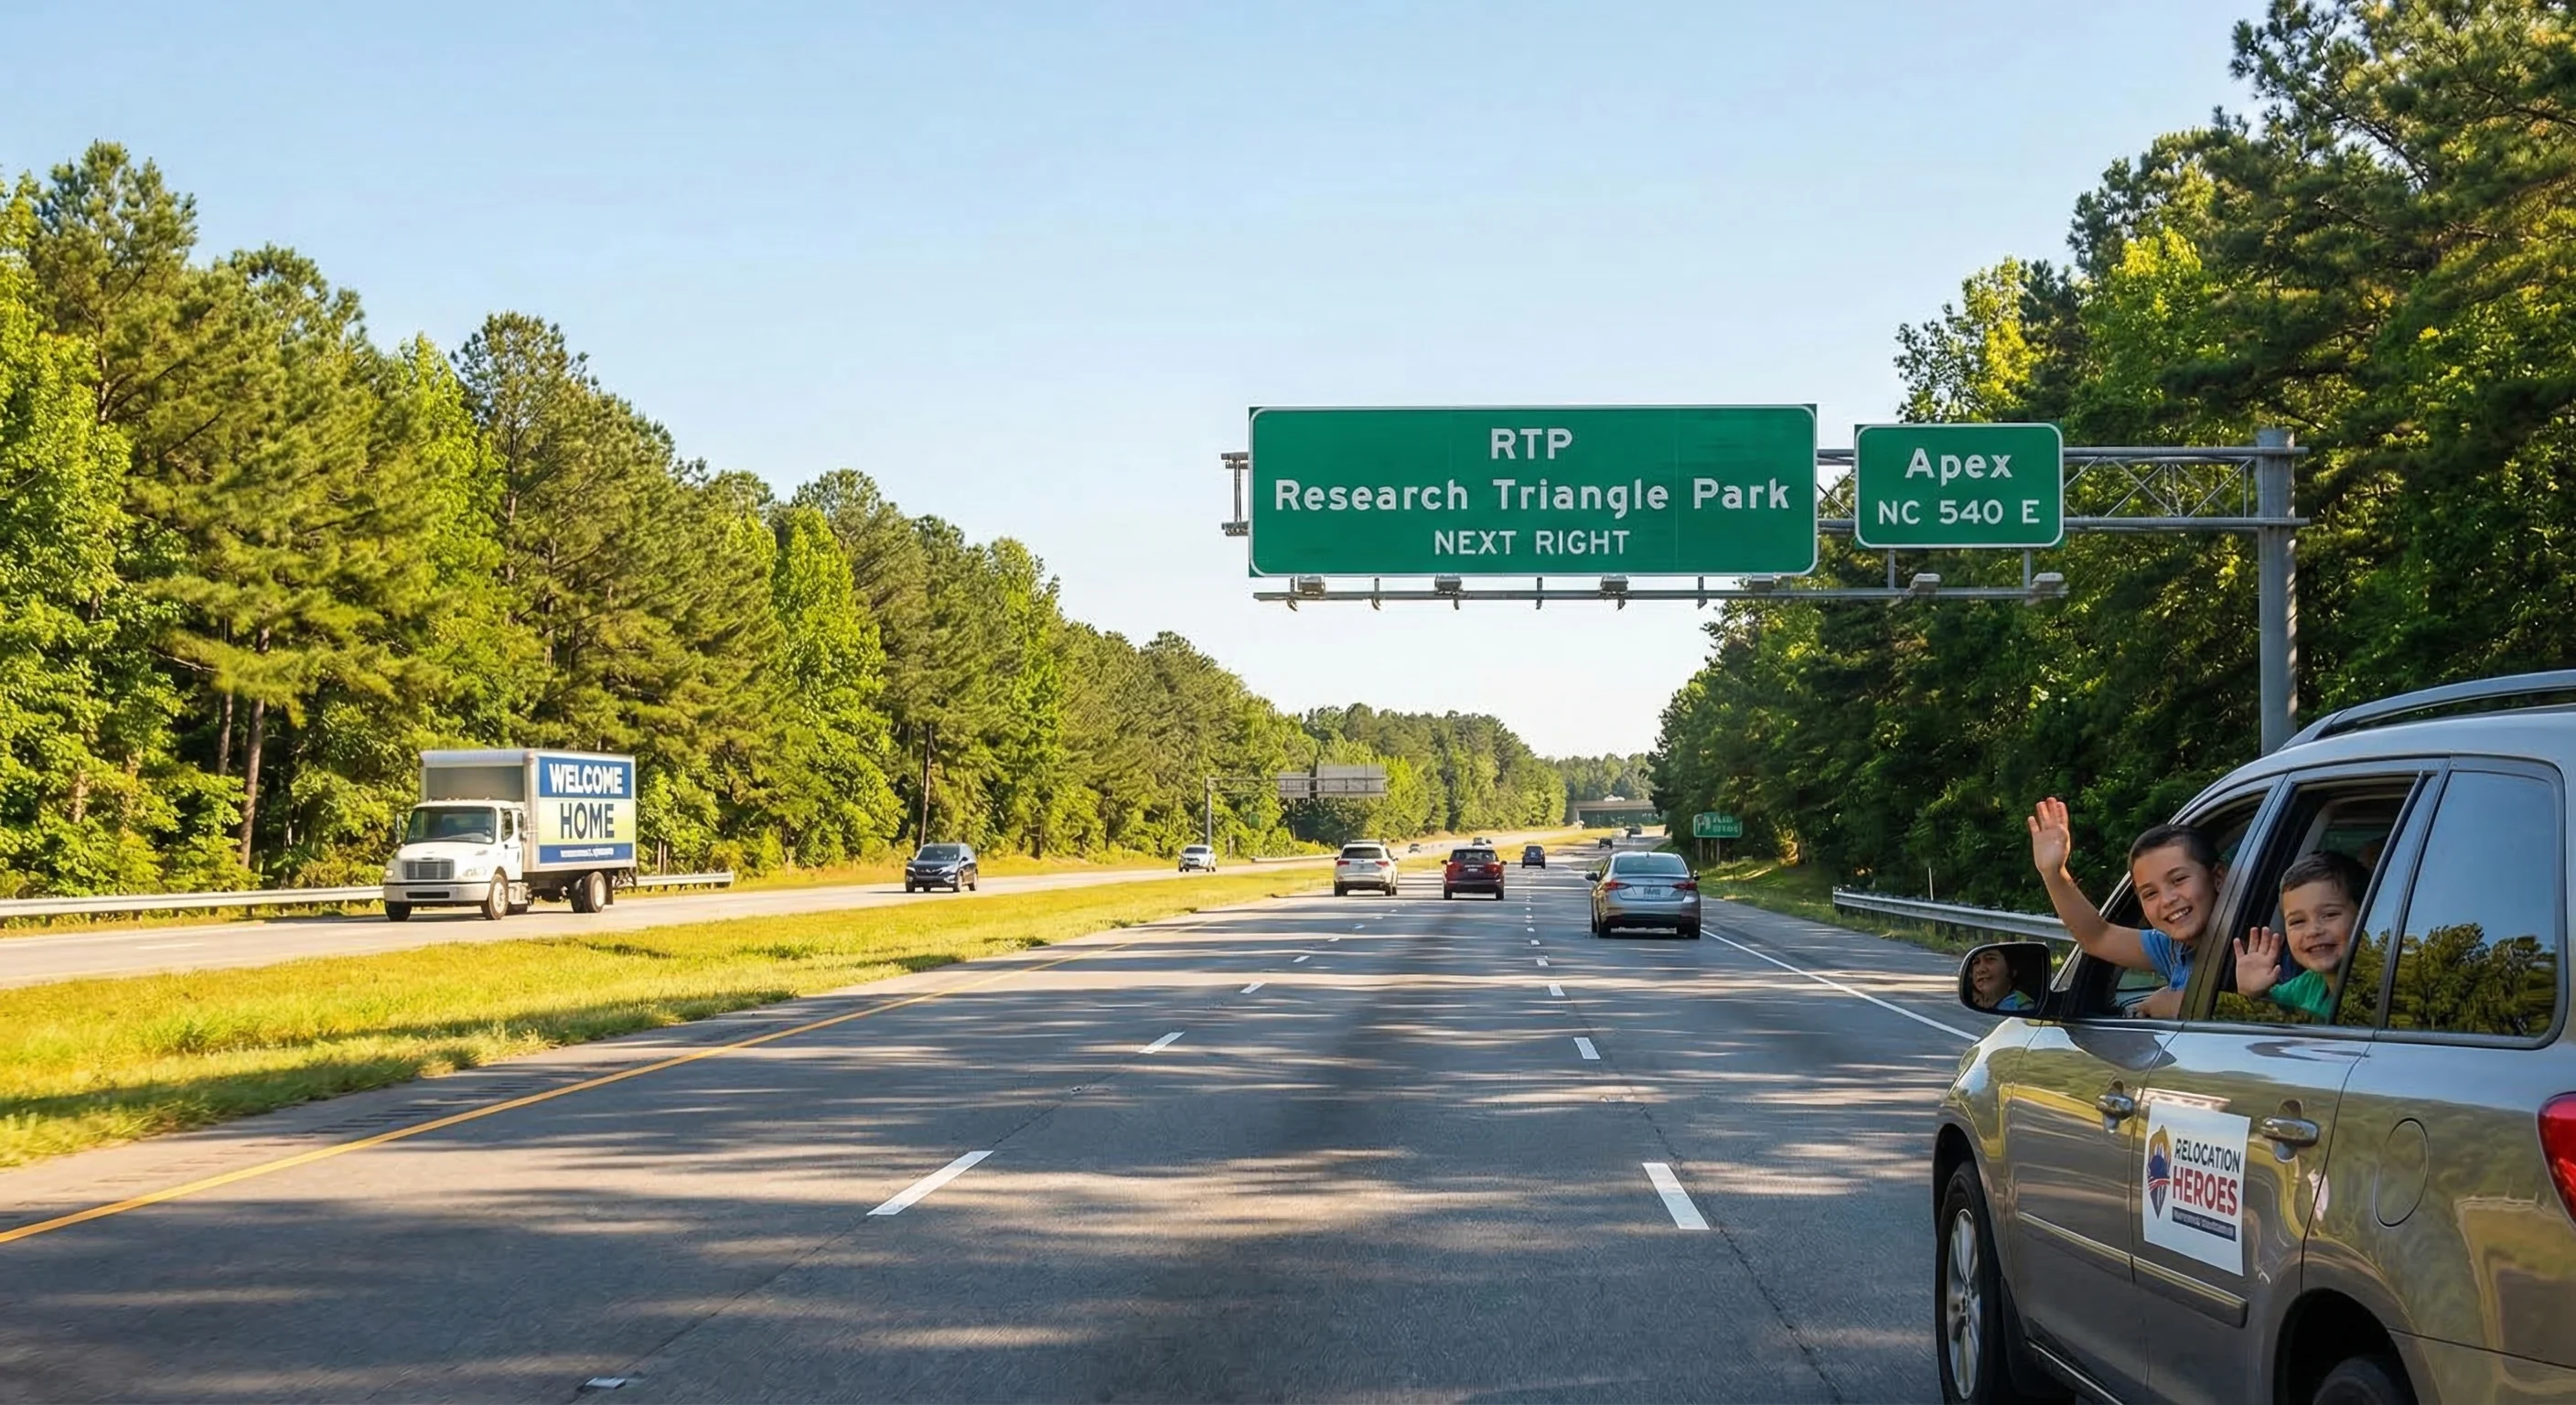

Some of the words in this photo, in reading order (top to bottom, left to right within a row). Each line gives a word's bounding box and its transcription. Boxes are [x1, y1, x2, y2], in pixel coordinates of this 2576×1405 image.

[1491, 428, 1572, 459] RTP
[1905, 448, 2012, 487] Apex
[1275, 479, 1467, 510] Research
[1492, 478, 1669, 520] Triangle
[1694, 478, 1789, 509] Park
[1878, 500, 1920, 524] NC
[1939, 499, 2003, 524] 540
[2022, 499, 2040, 524] E
[1435, 531, 1517, 555] NEXT
[1536, 530, 1629, 554] RIGHT
[549, 764, 623, 794] WELCOME
[560, 802, 615, 840] HOME
[2174, 1138, 2241, 1174] RELOCATION
[2172, 1165, 2238, 1217] HEROES
